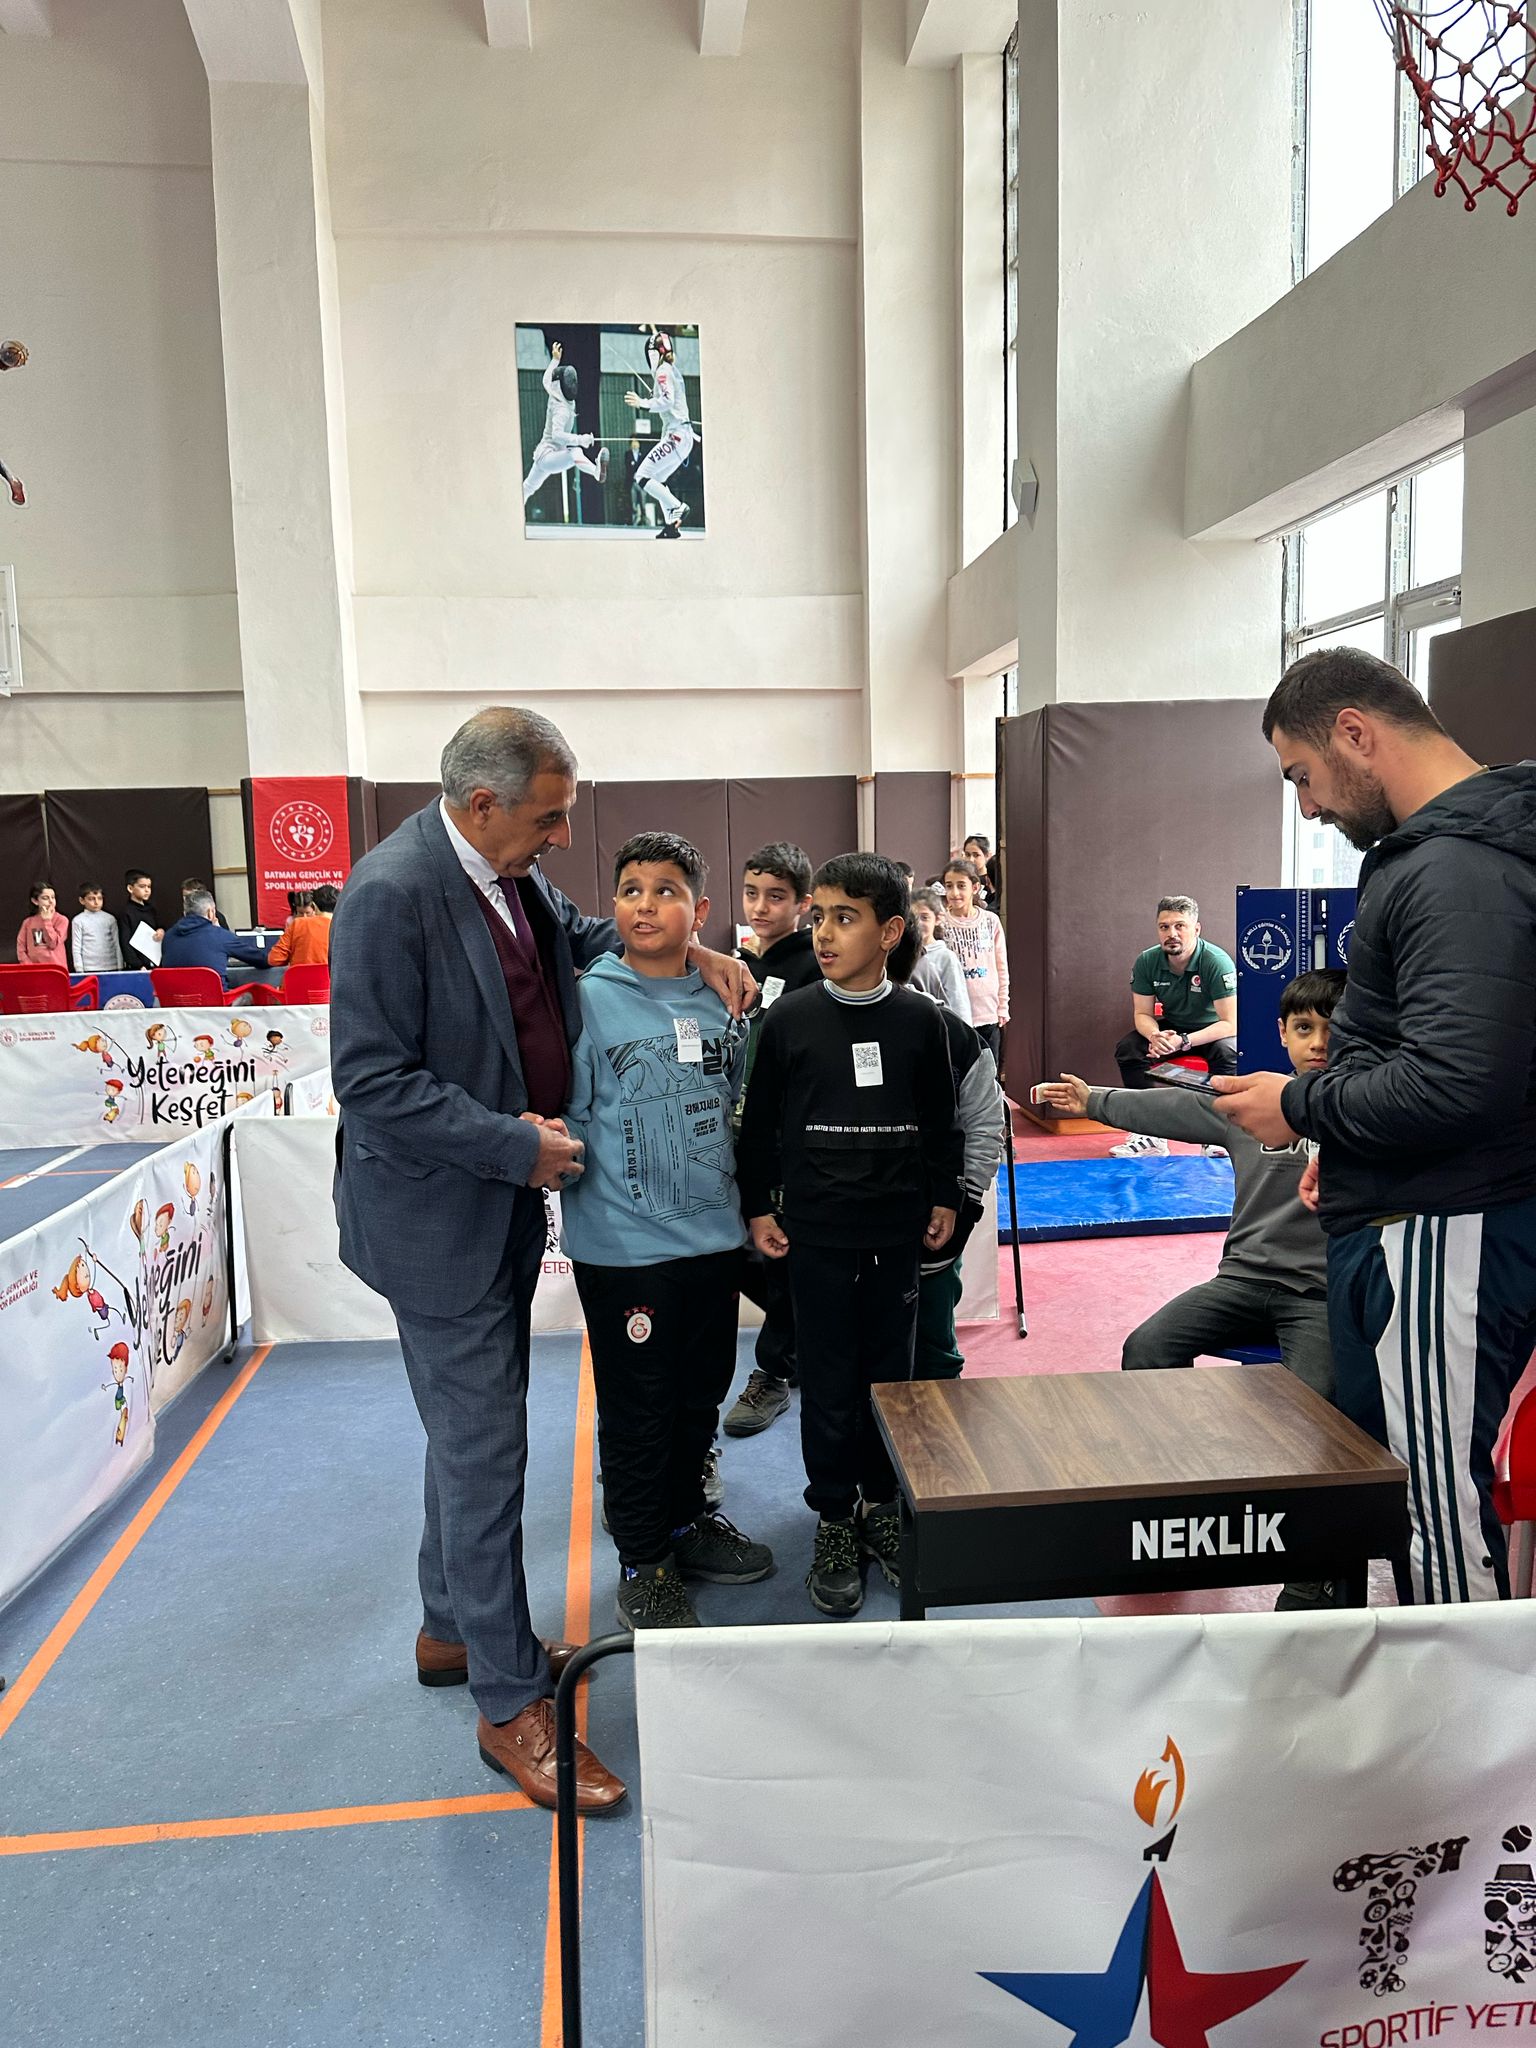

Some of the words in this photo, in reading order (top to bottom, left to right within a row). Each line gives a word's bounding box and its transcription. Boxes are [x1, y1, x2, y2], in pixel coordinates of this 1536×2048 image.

[648, 441, 676, 463] KOREA
[264, 870, 297, 879] BATMAN
[299, 869, 331, 880] GENÇLİK
[333, 870, 343, 879] VE
[265, 881, 286, 890] SPOR
[287, 880, 294, 890] İL
[127, 1056, 255, 1094] Yeteneğini
[1132, 1504, 1286, 1561] NEKLİK
[1320, 2001, 1458, 2048] SPORTİF
[1465, 2001, 1536, 2030] YET
